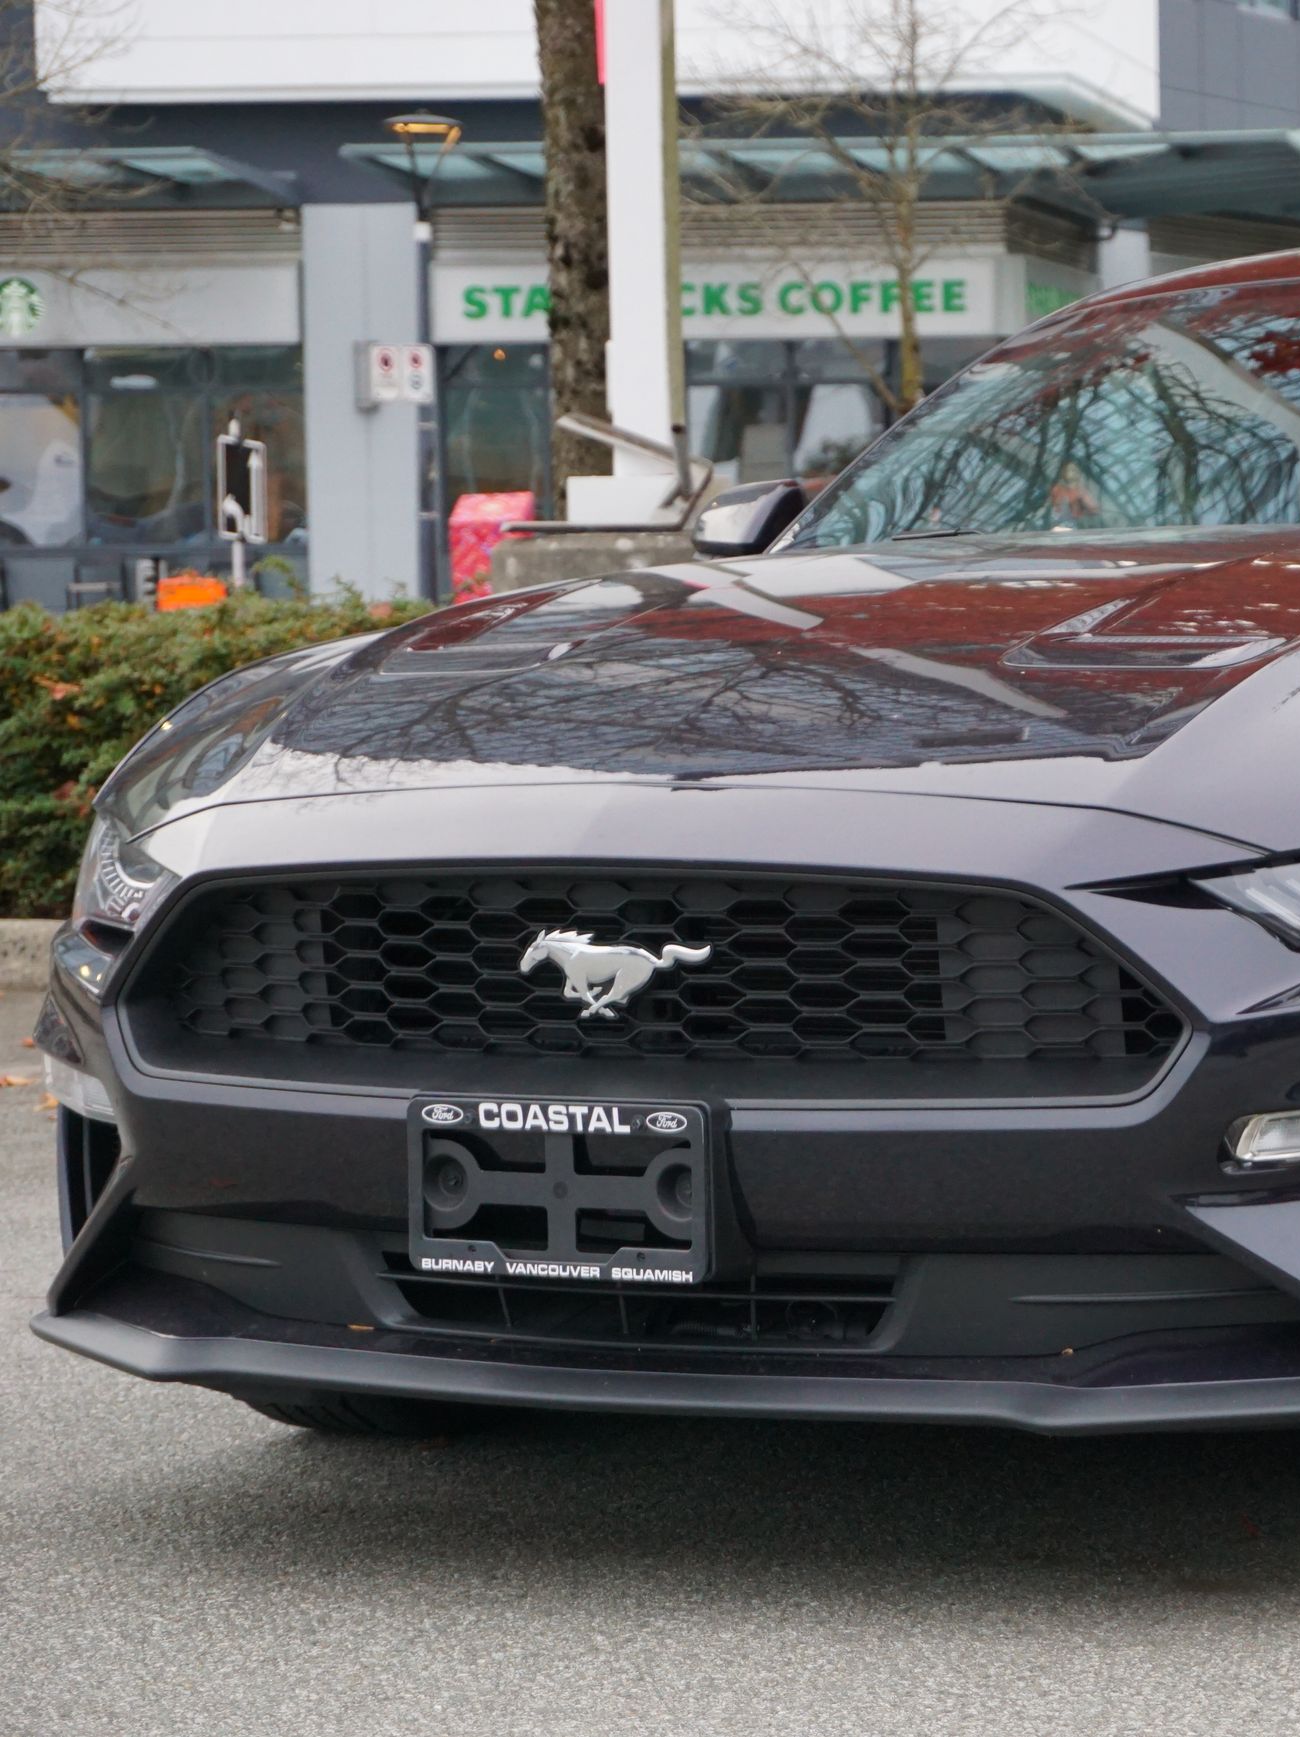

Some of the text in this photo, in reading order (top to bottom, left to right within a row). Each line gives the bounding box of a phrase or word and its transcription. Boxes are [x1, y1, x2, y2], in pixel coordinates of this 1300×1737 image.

[463, 280, 966, 319] STACKS COFFEE
[478, 1102, 631, 1134] COASTAL
[421, 1258, 693, 1283] BURNABY VANCOUVER SQUAMISH
